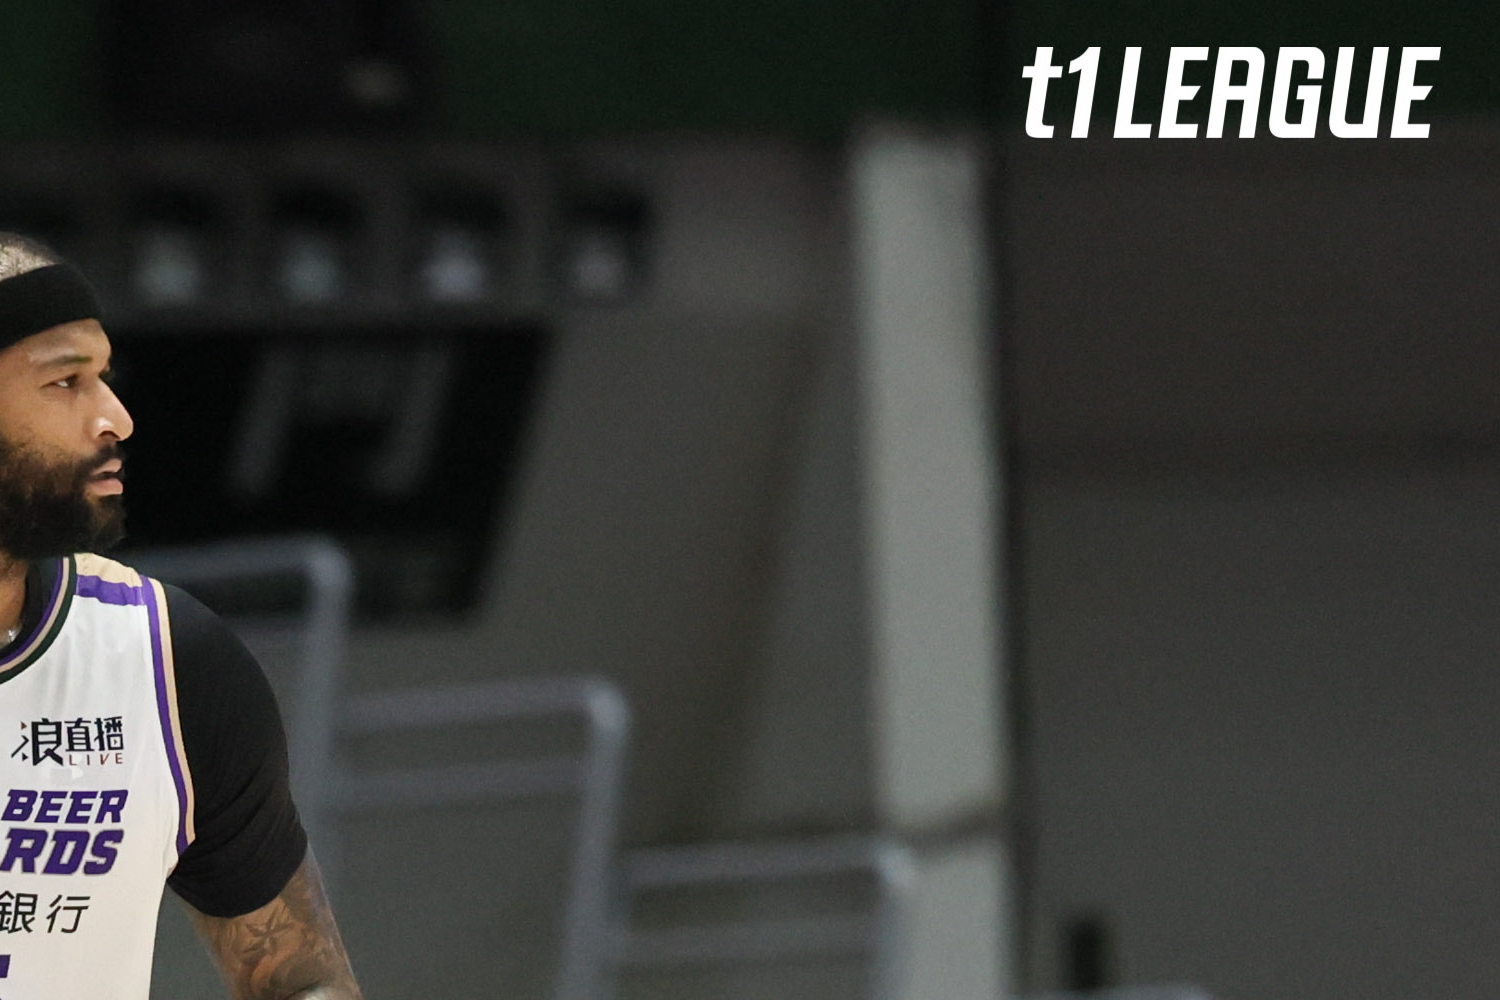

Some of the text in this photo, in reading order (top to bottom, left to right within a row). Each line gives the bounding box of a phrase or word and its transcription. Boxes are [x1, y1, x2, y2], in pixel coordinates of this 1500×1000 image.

[11, 716, 124, 766] 浪直播
[69, 753, 124, 766] LIVE
[0, 788, 129, 824] BEER
